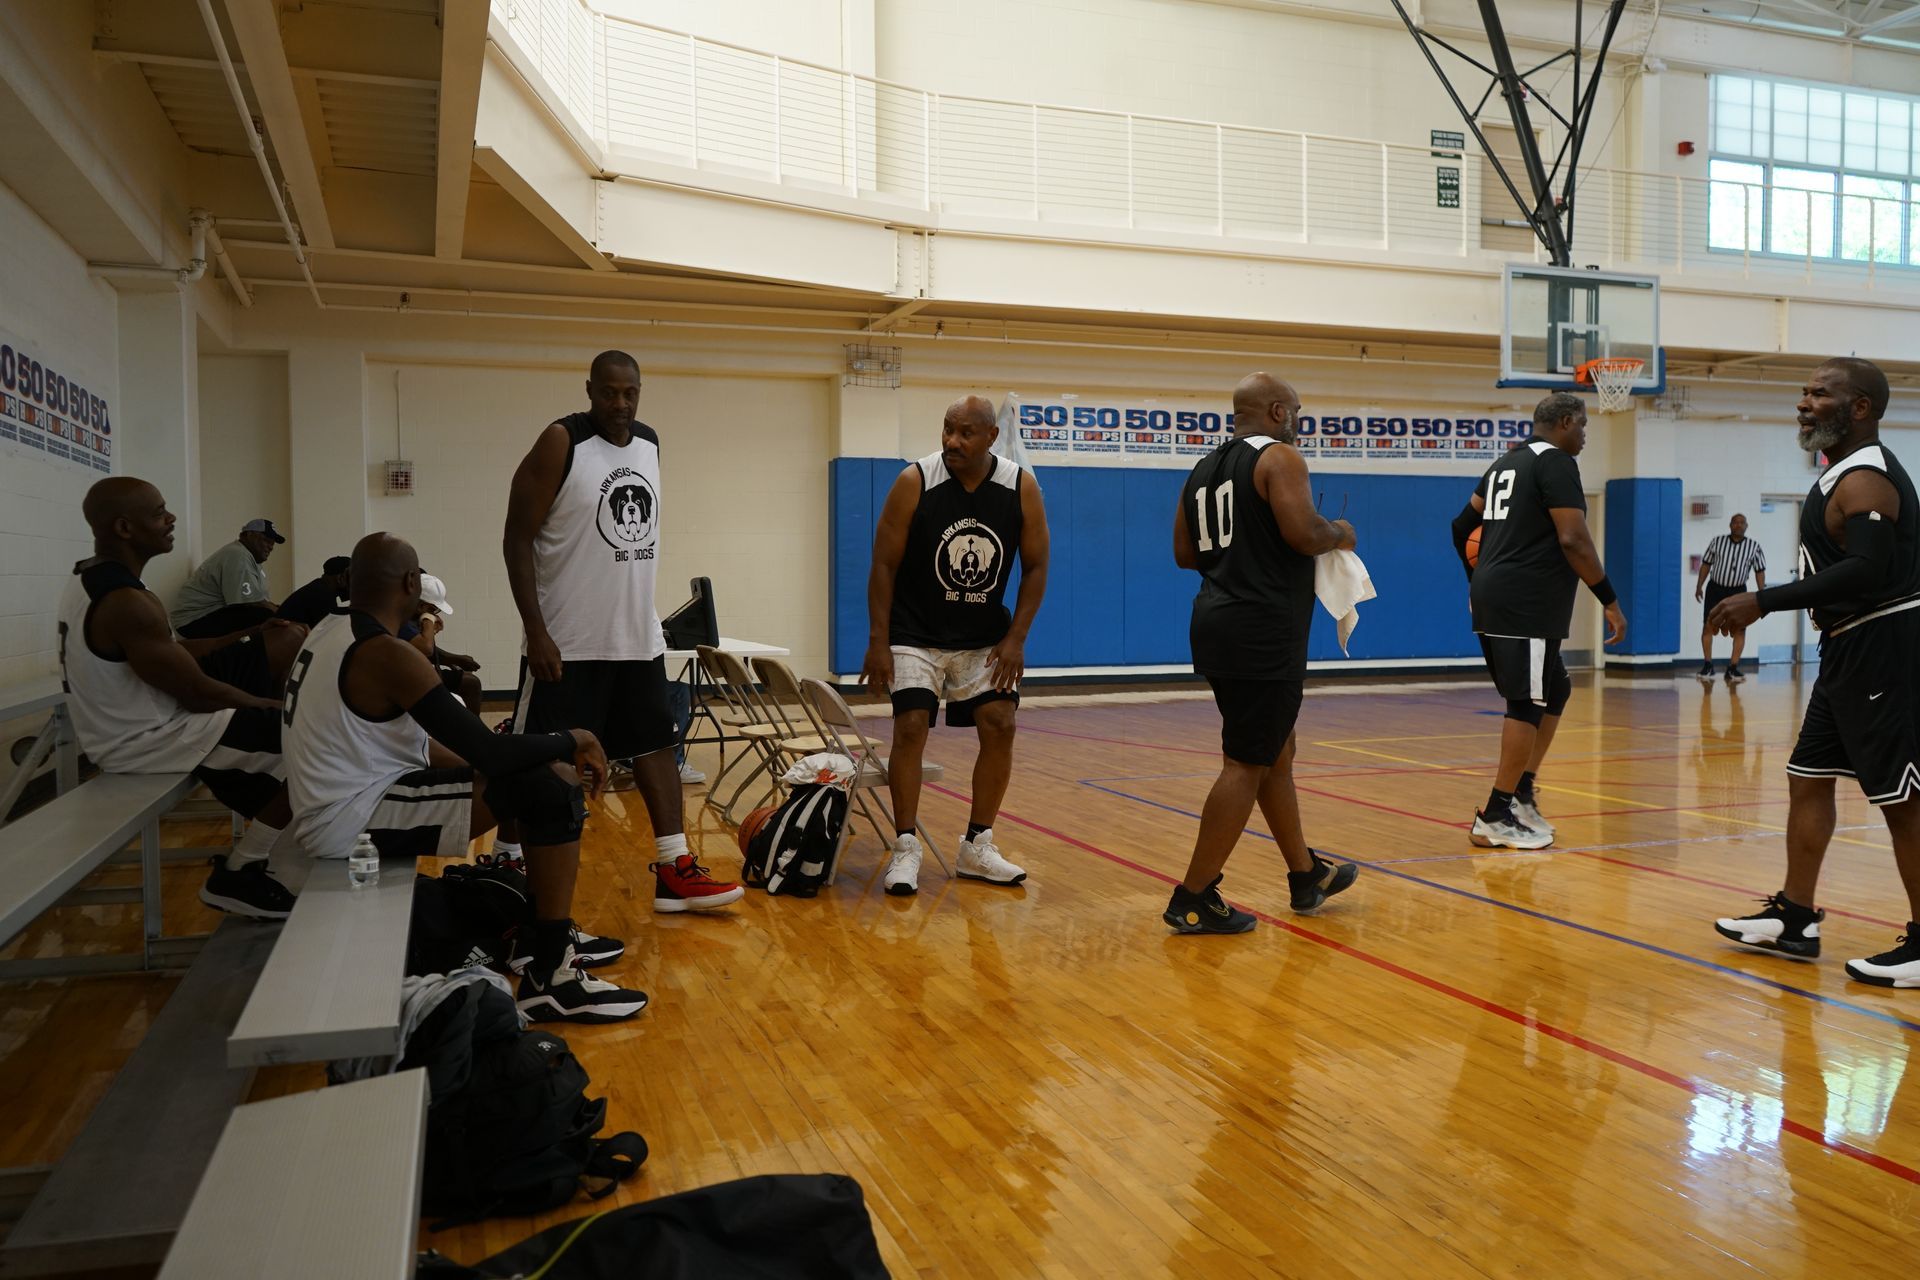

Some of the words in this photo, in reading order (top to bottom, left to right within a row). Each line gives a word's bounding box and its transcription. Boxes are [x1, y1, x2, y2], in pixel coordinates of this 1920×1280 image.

[0, 344, 16, 391] 0
[18, 352, 43, 403] 50
[45, 368, 69, 415] 50
[70, 382, 90, 426] 50
[91, 394, 111, 436] 50
[1020, 405, 1067, 427] 50
[1073, 407, 1119, 428] 50
[1126, 409, 1171, 430] 50
[1176, 411, 1221, 432] 50
[1321, 416, 1362, 436] 50
[1367, 417, 1408, 436] 50
[1412, 418, 1452, 437] 50
[1455, 419, 1494, 437] 50
[1498, 420, 1534, 438] 50
[1022, 429, 1068, 440] HOOPS
[1075, 431, 1119, 442] HOOPS
[1127, 433, 1170, 443] HOOPS
[1178, 434, 1220, 445] HOOPS
[1323, 438, 1362, 448] HOOPS
[1369, 438, 1407, 448] HOOPS
[600, 467, 631, 495] ARKANSAS
[1483, 469, 1516, 520] 12
[1195, 479, 1233, 552] 10
[941, 518, 977, 542] ARKANSAS
[615, 550, 629, 562] BIG
[634, 548, 654, 560] DOGS
[242, 582, 252, 595] 3
[945, 591, 959, 601] BIG
[965, 592, 987, 603] DOGS
